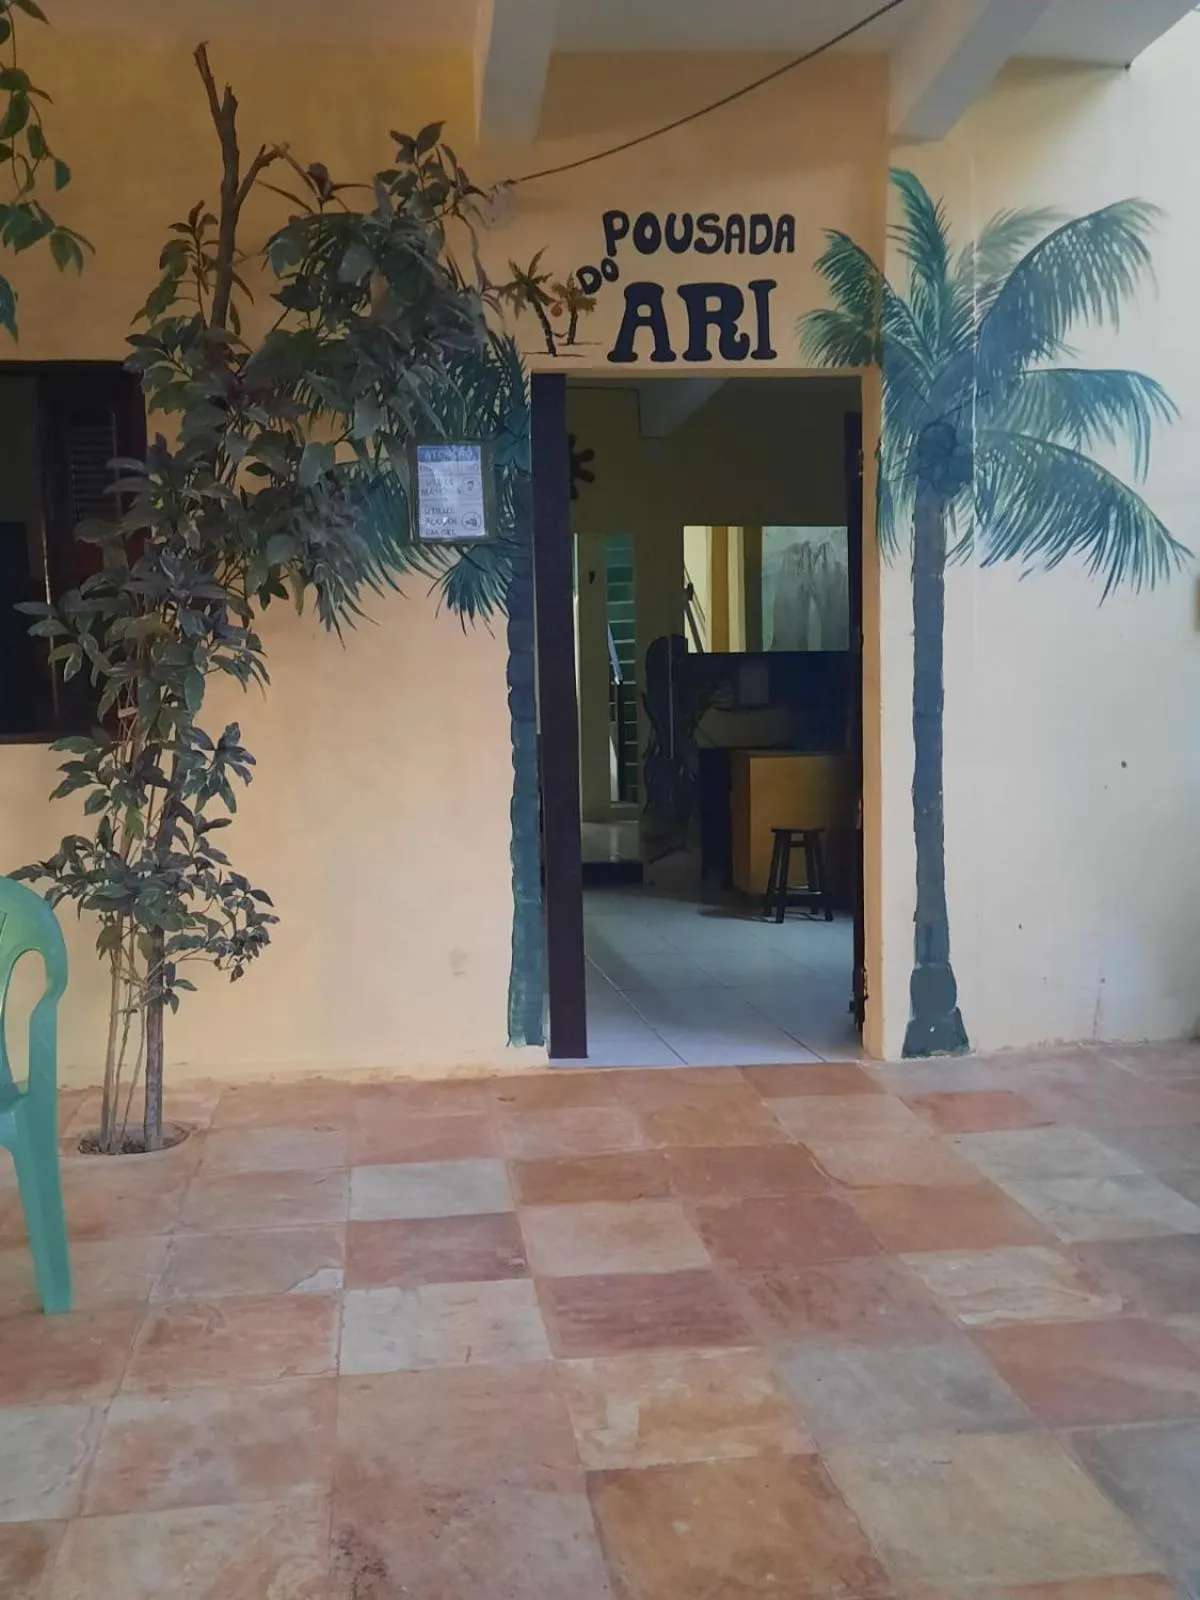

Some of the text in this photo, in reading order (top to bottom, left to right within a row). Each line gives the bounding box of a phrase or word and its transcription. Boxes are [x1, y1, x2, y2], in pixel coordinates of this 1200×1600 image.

[602, 209, 796, 257] POUSADA
[576, 258, 619, 295] DO
[607, 279, 778, 363] ARI
